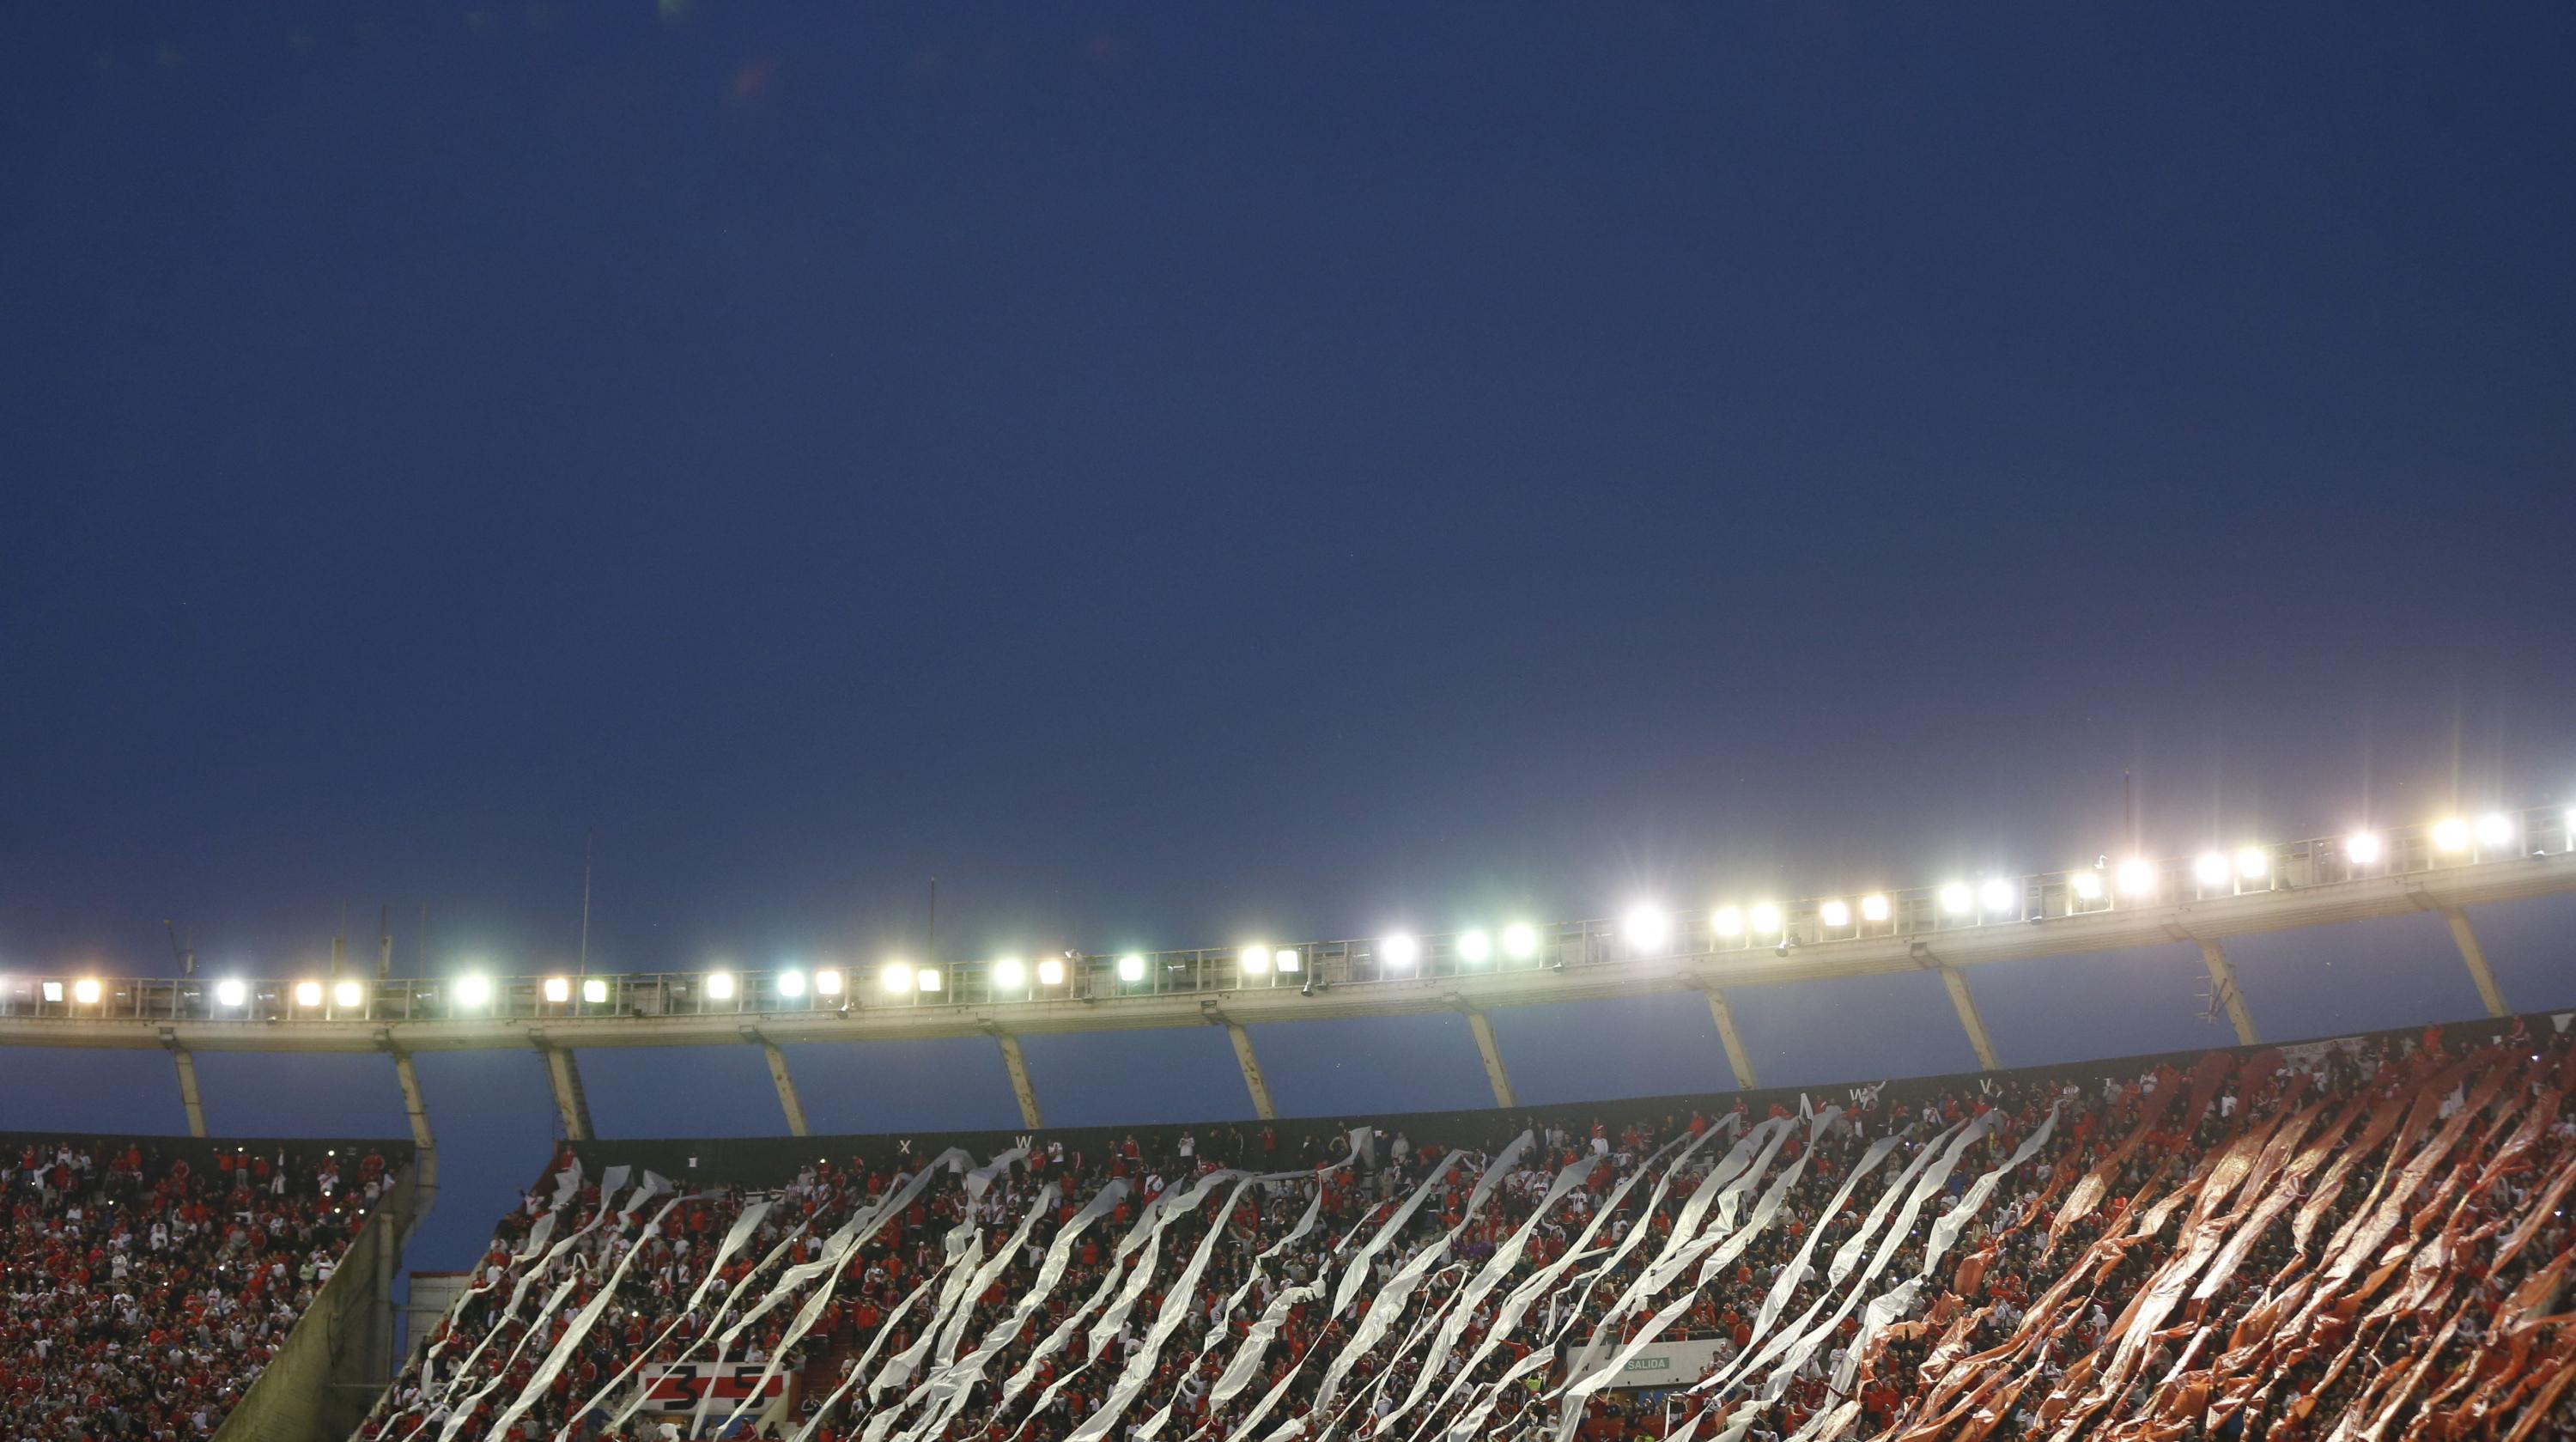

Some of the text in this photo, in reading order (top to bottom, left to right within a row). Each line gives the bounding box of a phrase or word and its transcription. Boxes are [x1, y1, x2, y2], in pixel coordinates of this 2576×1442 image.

[900, 1140, 911, 1154] X
[1015, 1135, 1032, 1149] W
[1628, 1360, 1665, 1370] SALIDA
